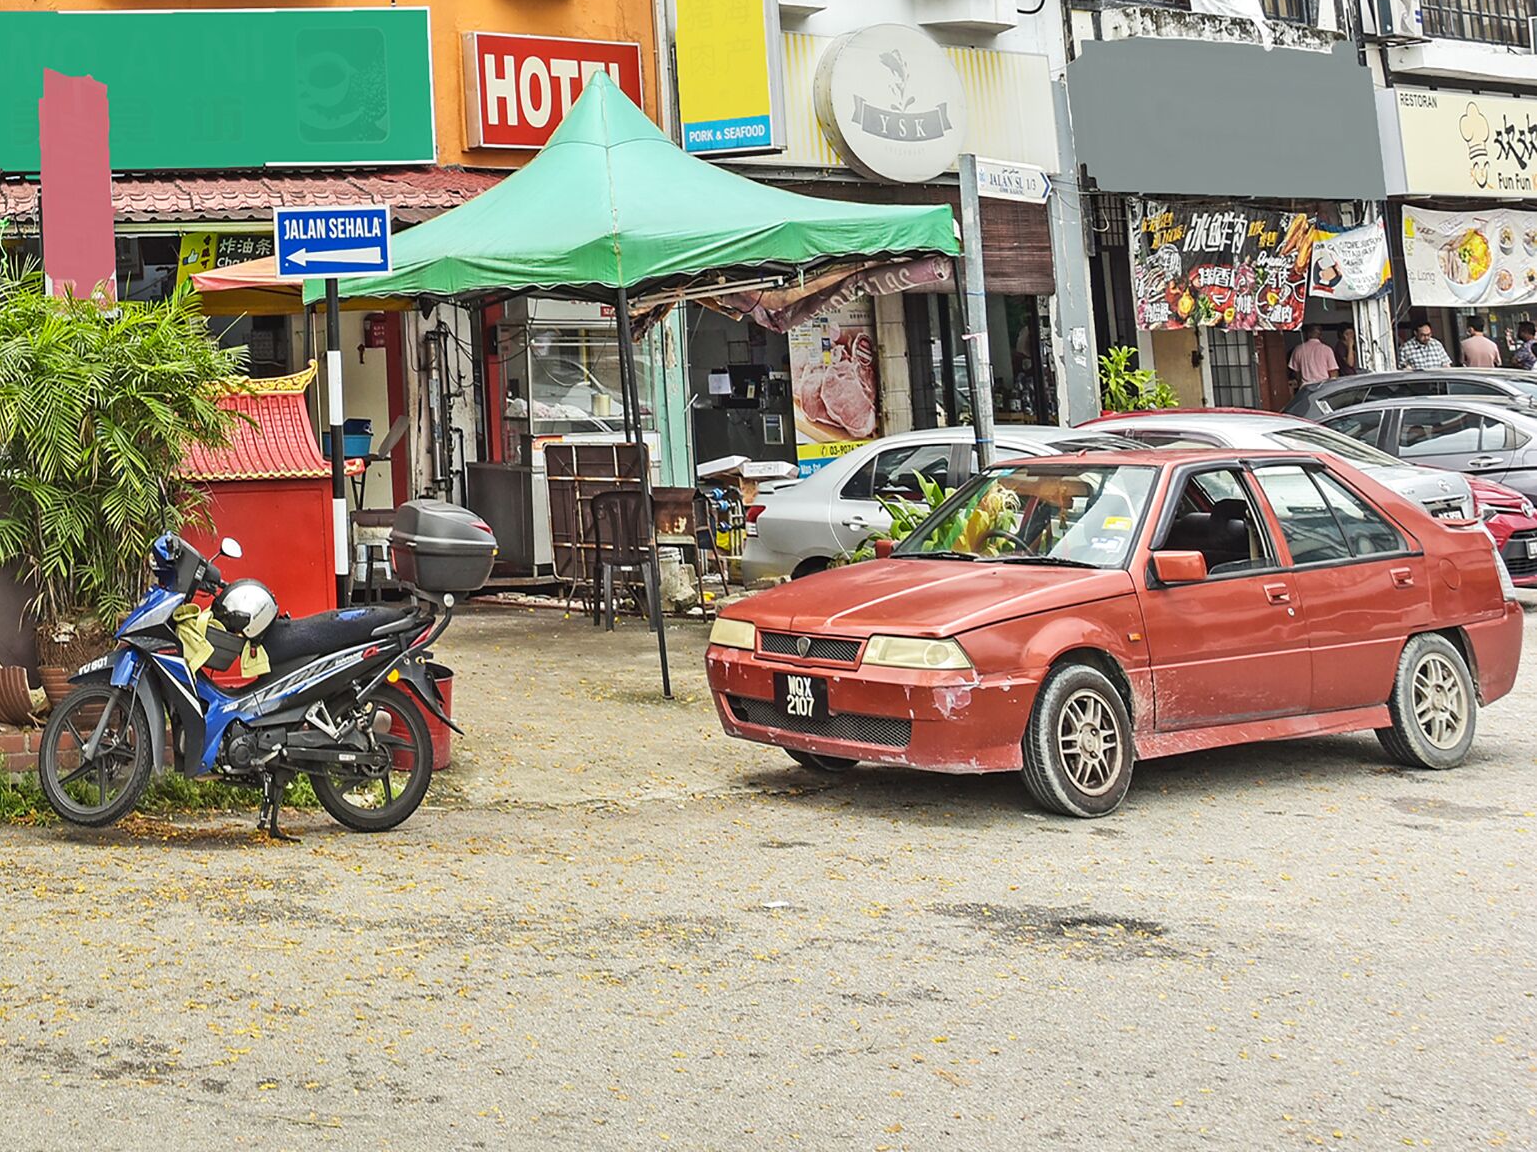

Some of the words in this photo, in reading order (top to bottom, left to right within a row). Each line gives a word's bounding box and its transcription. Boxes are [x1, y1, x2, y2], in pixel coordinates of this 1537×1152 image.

[1399, 93, 1438, 109] RESTORAN
[689, 130, 714, 143] PORK
[715, 131, 723, 141] &
[724, 124, 766, 140] SEAFOOD
[989, 173, 1013, 188] JALAN
[1497, 172, 1514, 190] Fun
[1515, 173, 1532, 190] Fun
[283, 218, 326, 240] JALAN
[329, 217, 381, 239] SEHALA
[219, 237, 272, 256] 炸油条
[787, 675, 812, 697] WQX
[786, 696, 815, 718] 2107
